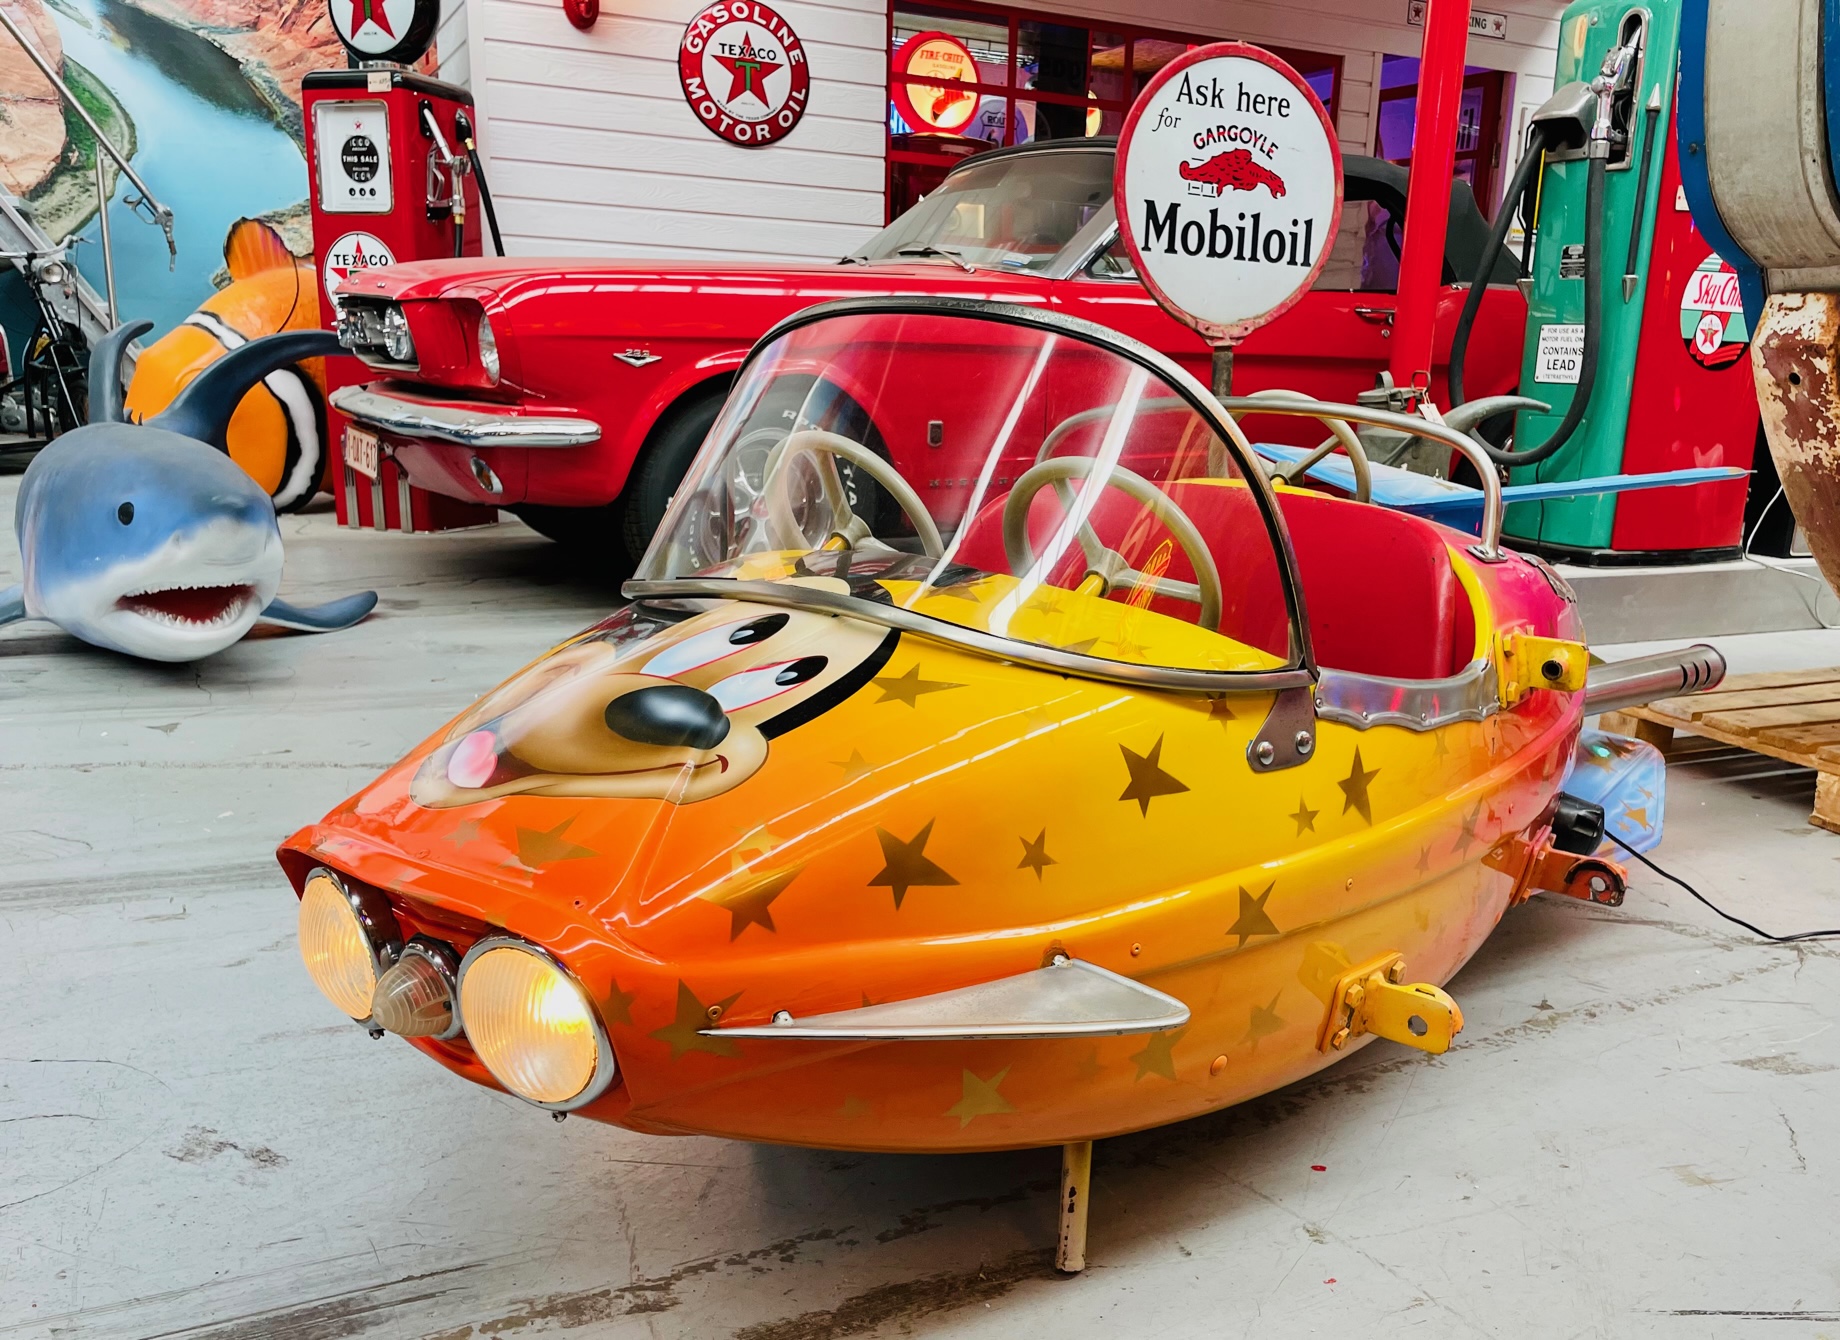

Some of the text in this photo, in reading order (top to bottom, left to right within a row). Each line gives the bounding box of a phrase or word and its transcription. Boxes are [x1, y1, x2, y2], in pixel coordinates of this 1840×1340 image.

[686, 1, 804, 66] GASOLINE
[718, 42, 777, 61] TEXACO
[920, 50, 964, 64] FIRE-CHIEF
[735, 61, 760, 91] T
[1176, 71, 1290, 118] Ask here
[686, 77, 806, 141] MOTOR OIL
[1152, 107, 1182, 132] for
[1193, 125, 1279, 160] GARGOYLE
[343, 155, 378, 163] THIS SALE
[1141, 198, 1313, 267] Mobiloil
[334, 254, 388, 266] TEXACO
[1694, 274, 1721, 309] Sky
[1542, 346, 1584, 356] CONTAINS
[1546, 358, 1576, 371] LEAD
